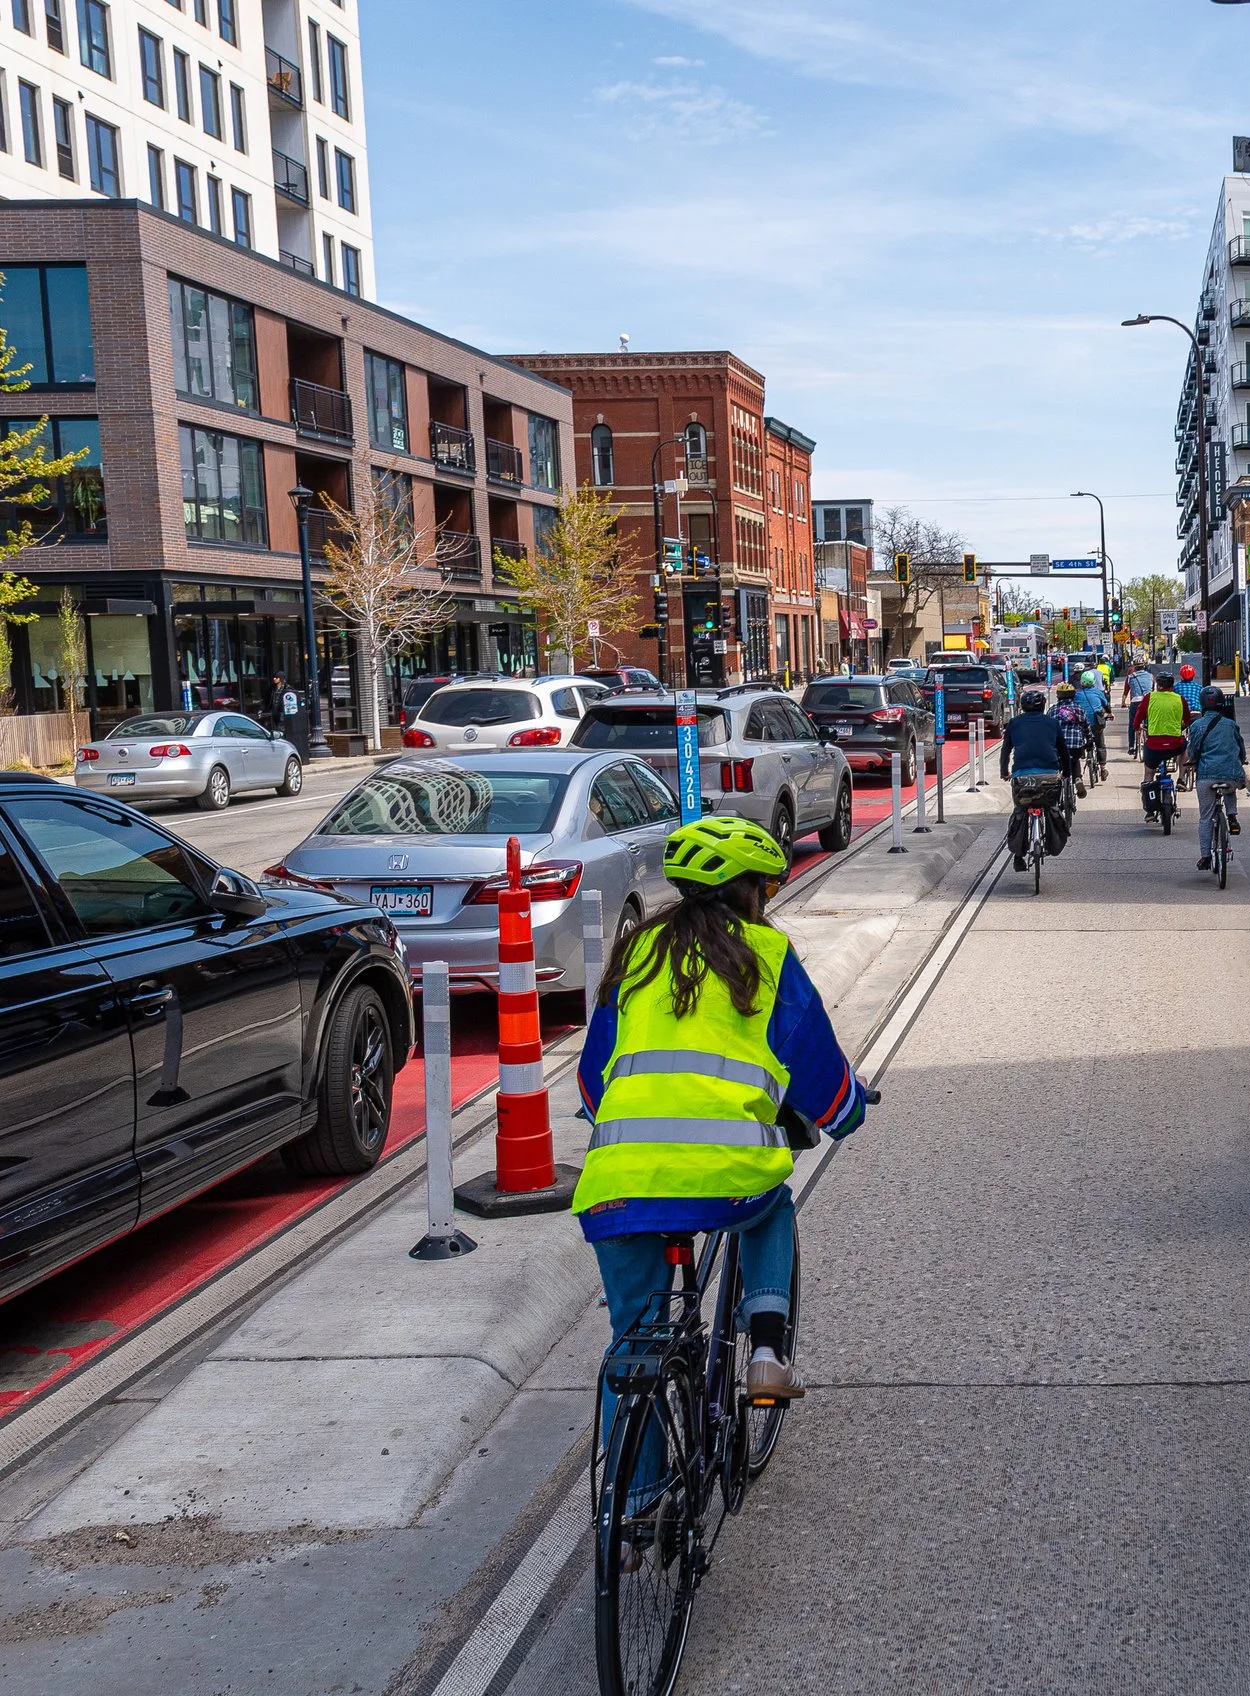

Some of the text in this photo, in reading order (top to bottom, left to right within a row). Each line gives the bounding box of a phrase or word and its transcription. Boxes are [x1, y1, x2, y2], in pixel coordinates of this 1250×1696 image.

[690, 460, 706, 470] ICE
[689, 472, 707, 481] OUT
[683, 725, 695, 810] 30420
[375, 894, 429, 908] YAJ 360
